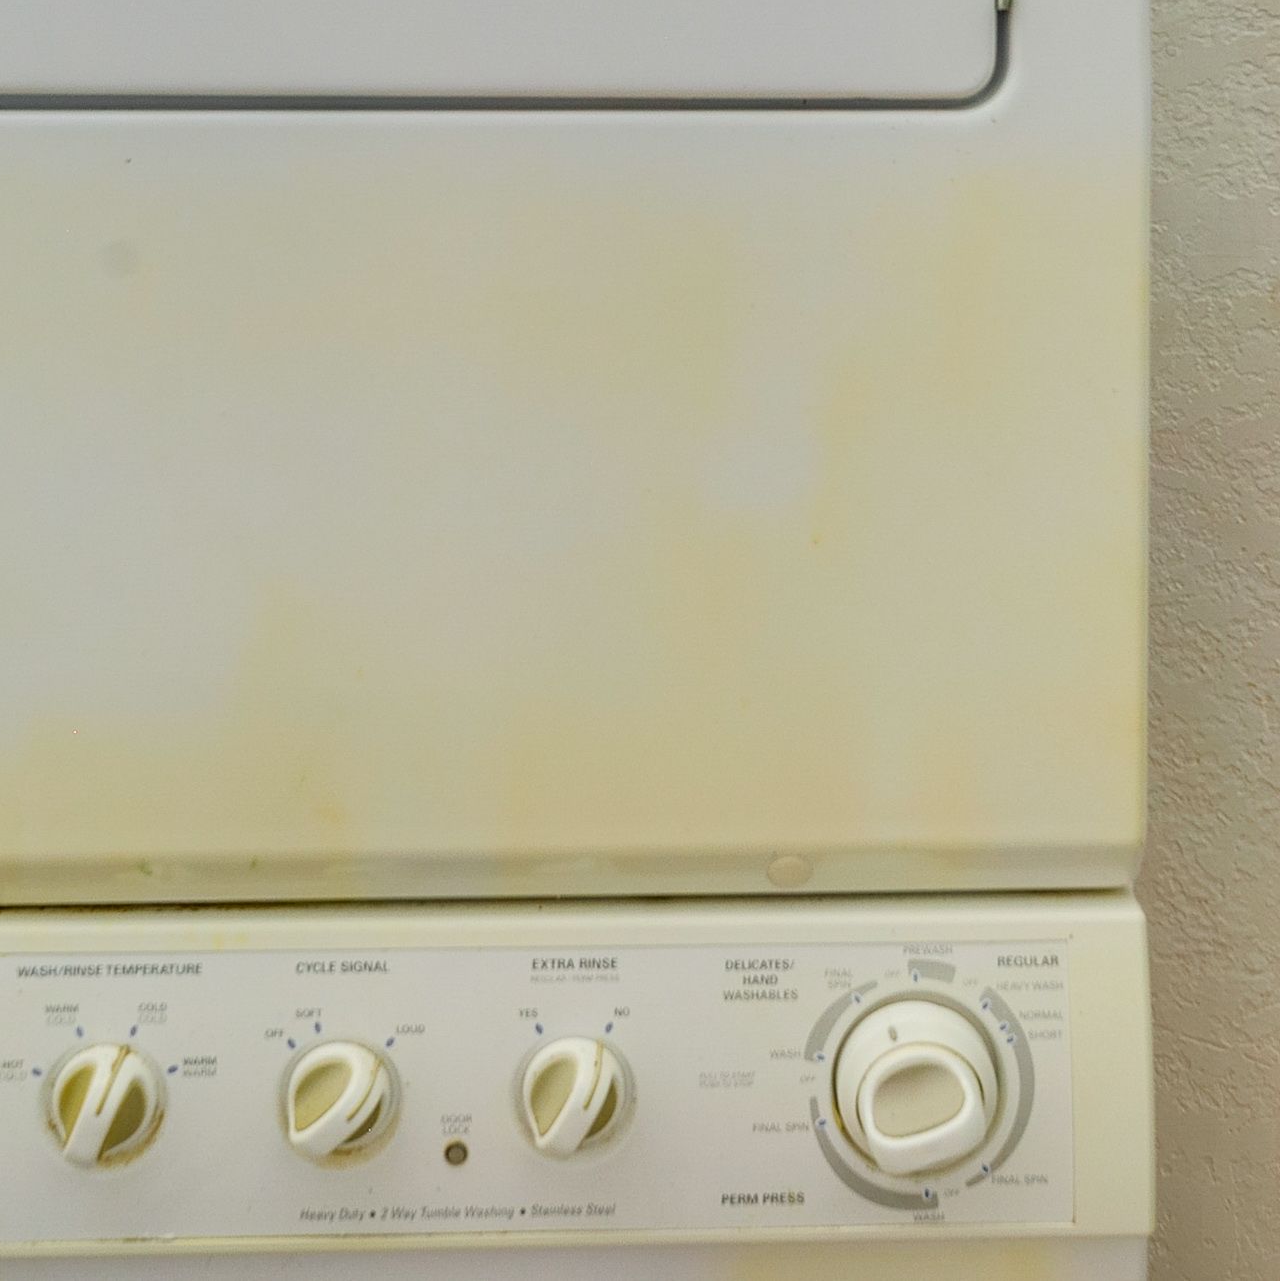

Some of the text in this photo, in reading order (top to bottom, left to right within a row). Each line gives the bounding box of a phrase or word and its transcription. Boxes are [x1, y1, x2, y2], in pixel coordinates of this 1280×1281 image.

[295, 960, 390, 974] CYCLE SIGNAL
[531, 957, 618, 970] EXTRA RINSE
[725, 959, 795, 971] DELICATES/
[997, 955, 1060, 967] REGULAR
[17, 961, 203, 978] WASH/RINSE TEMPERATURE
[742, 973, 778, 985] HAND
[996, 980, 1064, 991] HEAVY WASH
[723, 988, 799, 1001] WASHABLES
[295, 1008, 322, 1018] SOFT
[518, 1008, 538, 1018] YES
[614, 1007, 631, 1017] NO
[1019, 1009, 1064, 1020] NORMAL
[396, 1024, 426, 1034] LOUD
[769, 1048, 801, 1060] WASH
[752, 1122, 782, 1133] FINAL
[991, 1174, 1021, 1185] FINAL
[721, 1191, 805, 1206] PERM PRESS
[300, 1208, 335, 1221] Heavy
[339, 1208, 365, 1221] Duty
[391, 1208, 416, 1221] Way
[421, 1206, 460, 1218] Tumble
[465, 1206, 515, 1220] Washing
[531, 1204, 583, 1216] Stainless
[585, 1202, 616, 1215] Steel
[913, 1212, 945, 1222] WASH
